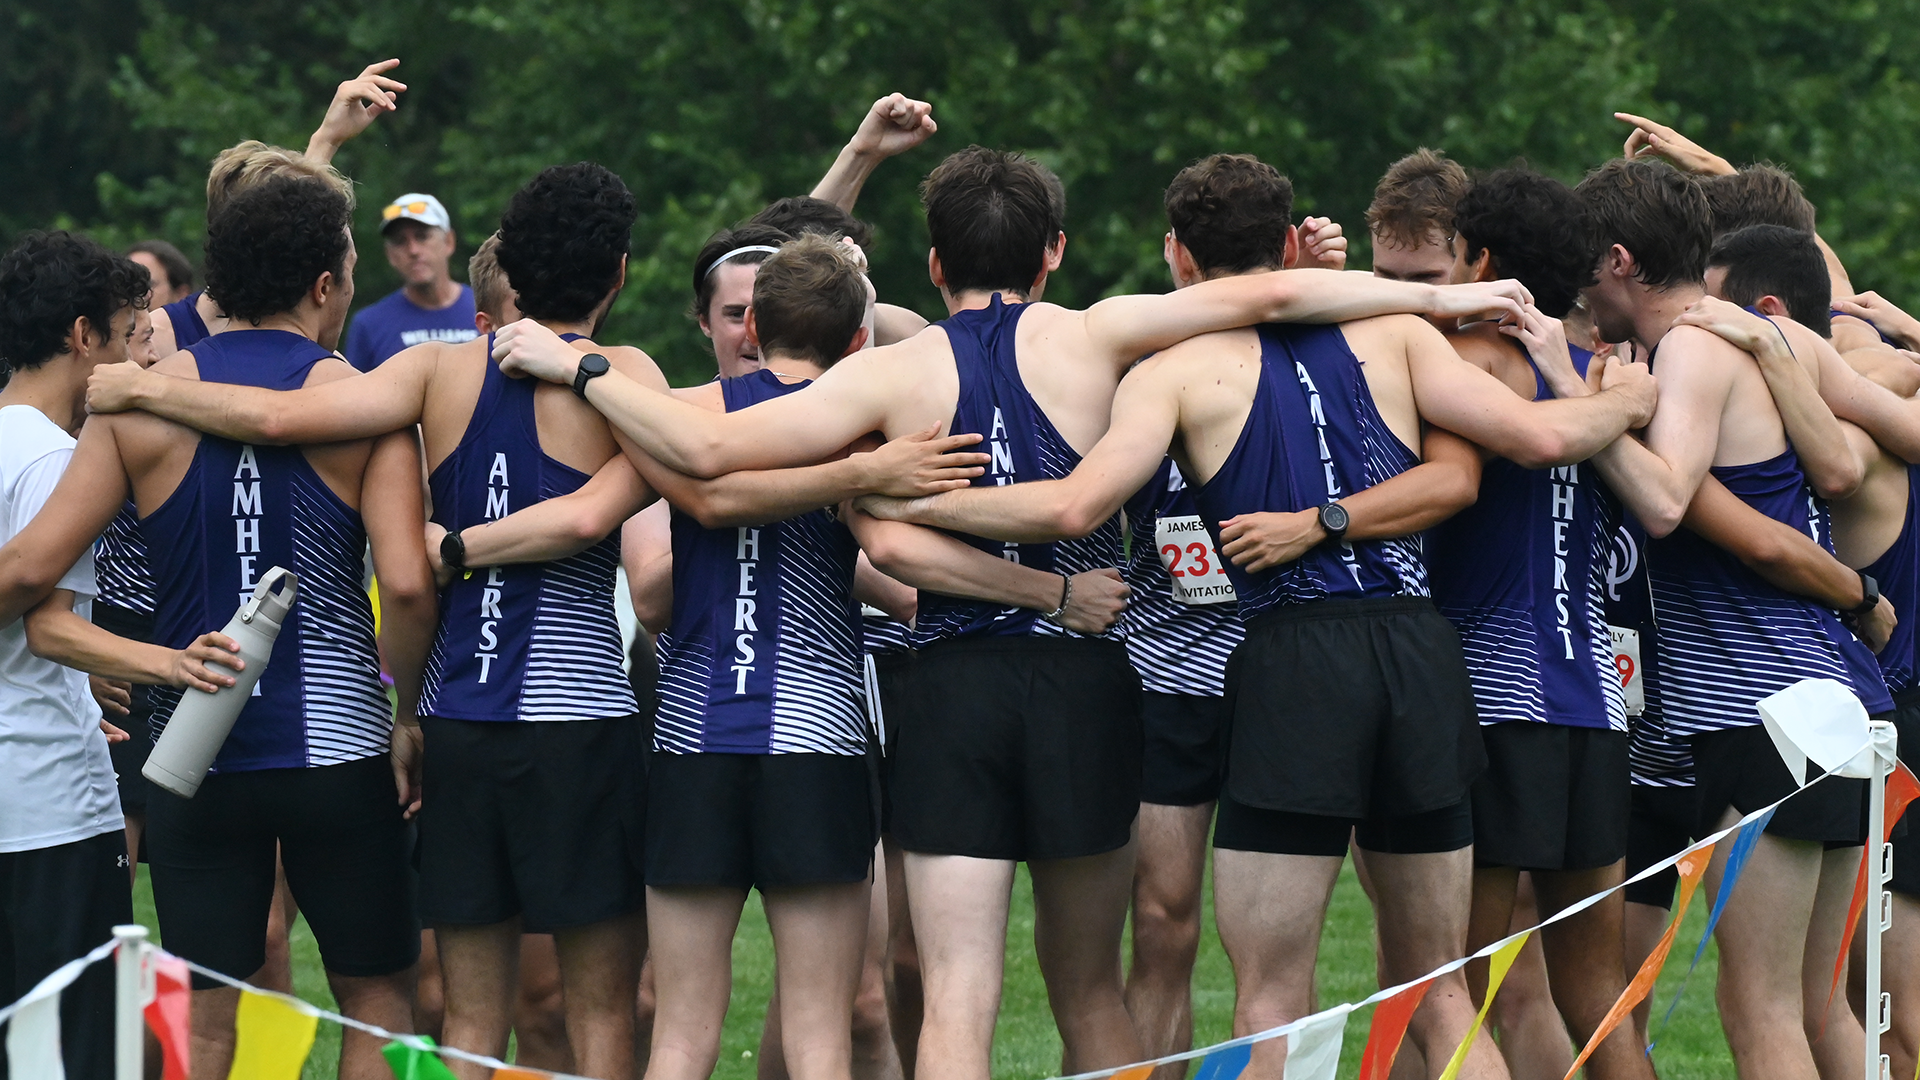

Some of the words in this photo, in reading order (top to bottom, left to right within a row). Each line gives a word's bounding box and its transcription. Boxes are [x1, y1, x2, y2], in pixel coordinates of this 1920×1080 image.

[474, 452, 509, 684] AMERST
[730, 525, 760, 694] HERST
[1161, 542, 1226, 578] 23
[1167, 521, 1205, 533] JAMES
[1550, 463, 1579, 660] MHERST
